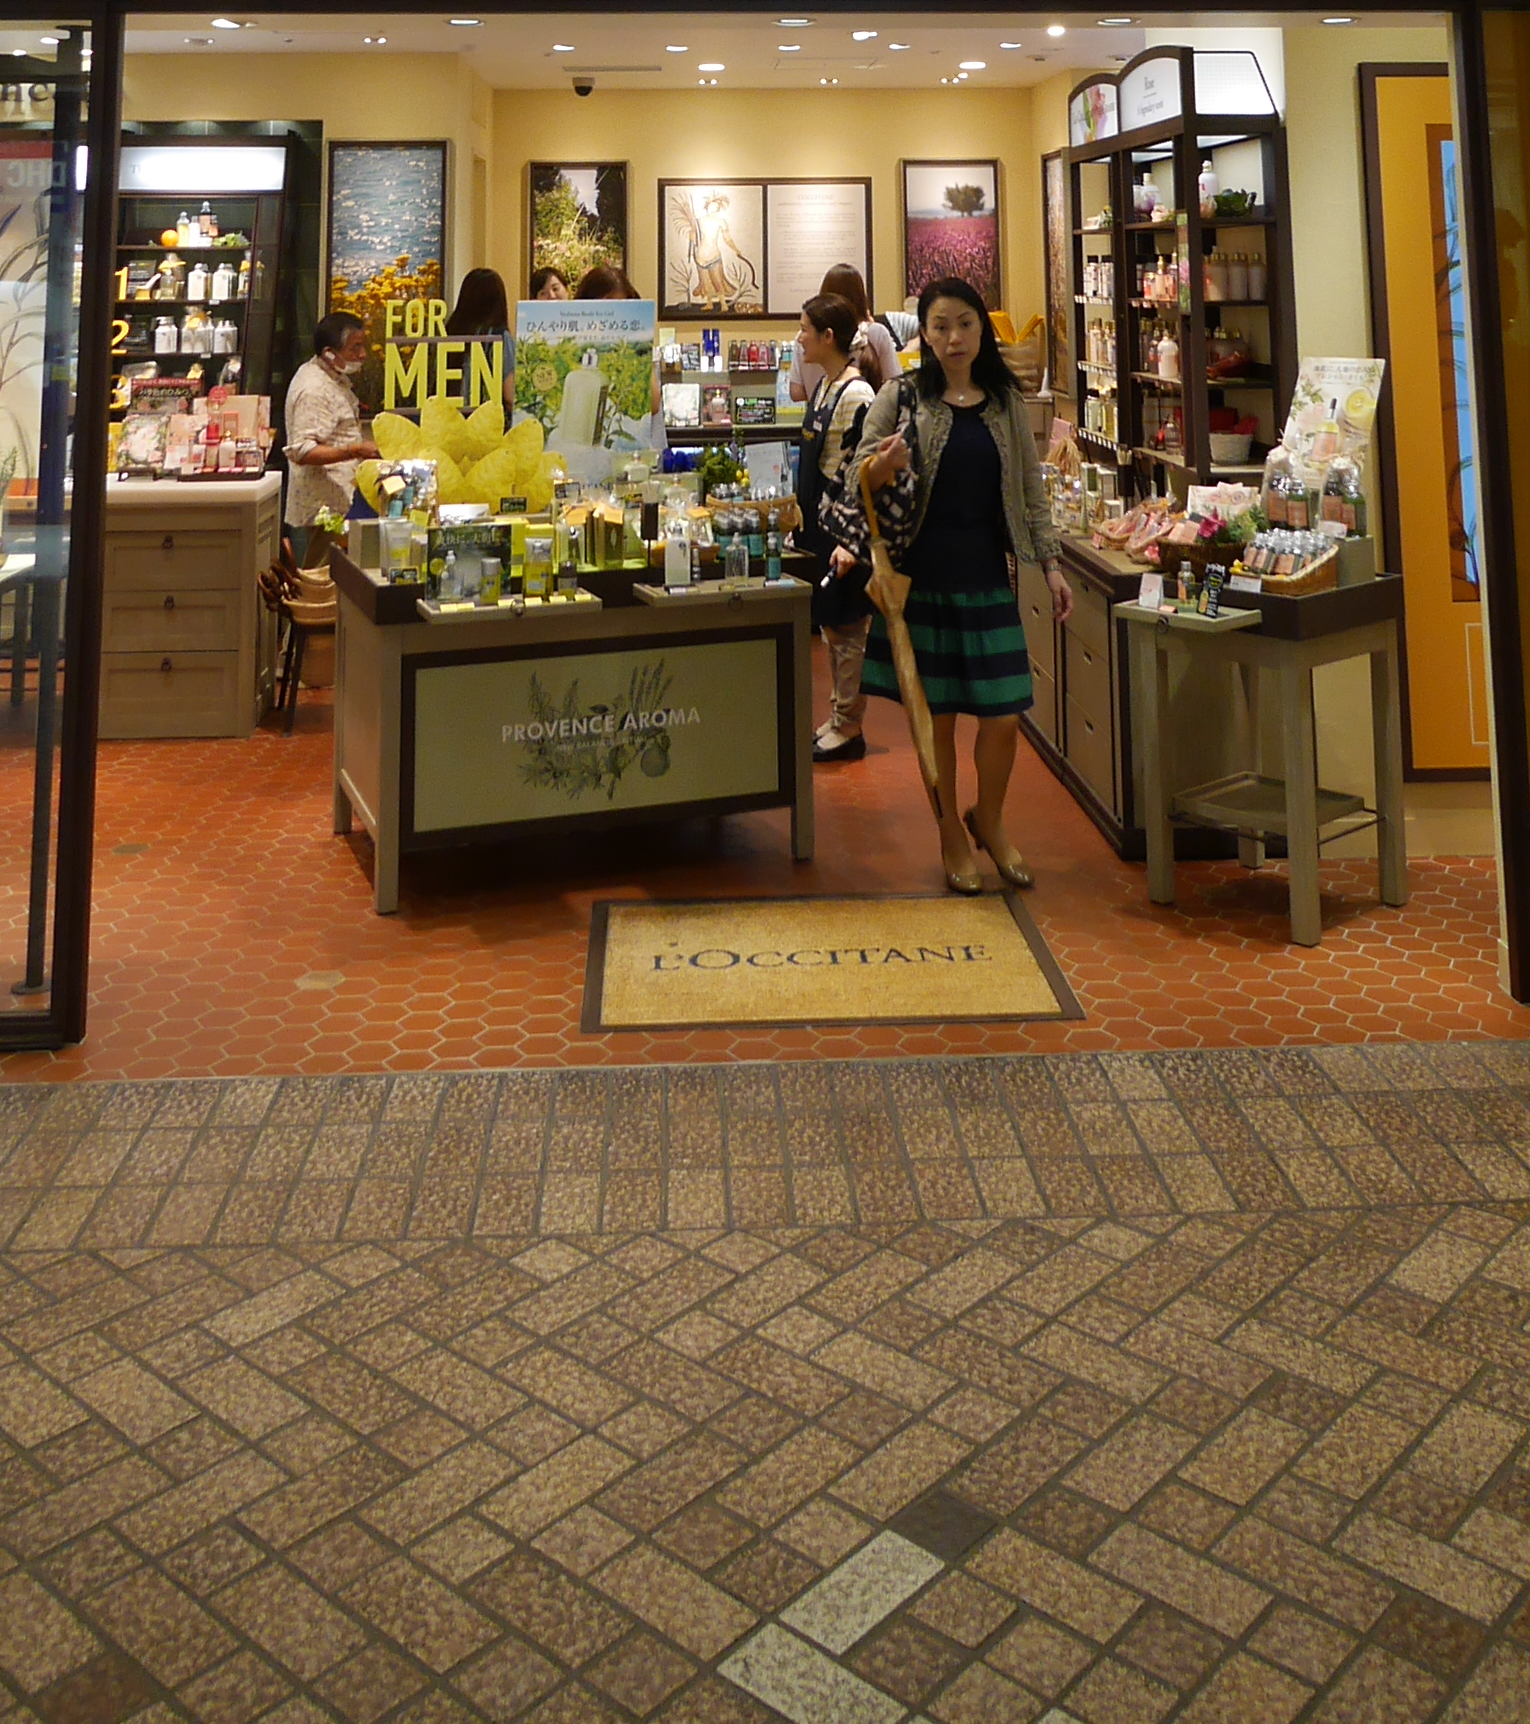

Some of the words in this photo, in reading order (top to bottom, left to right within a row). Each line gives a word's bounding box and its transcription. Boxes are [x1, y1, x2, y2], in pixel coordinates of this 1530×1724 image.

[385, 298, 448, 338] FOR
[384, 341, 504, 410] MEN
[501, 714, 616, 743] PROVENCE
[622, 705, 701, 731] AROMA
[650, 944, 994, 972] L'OCCITANE
